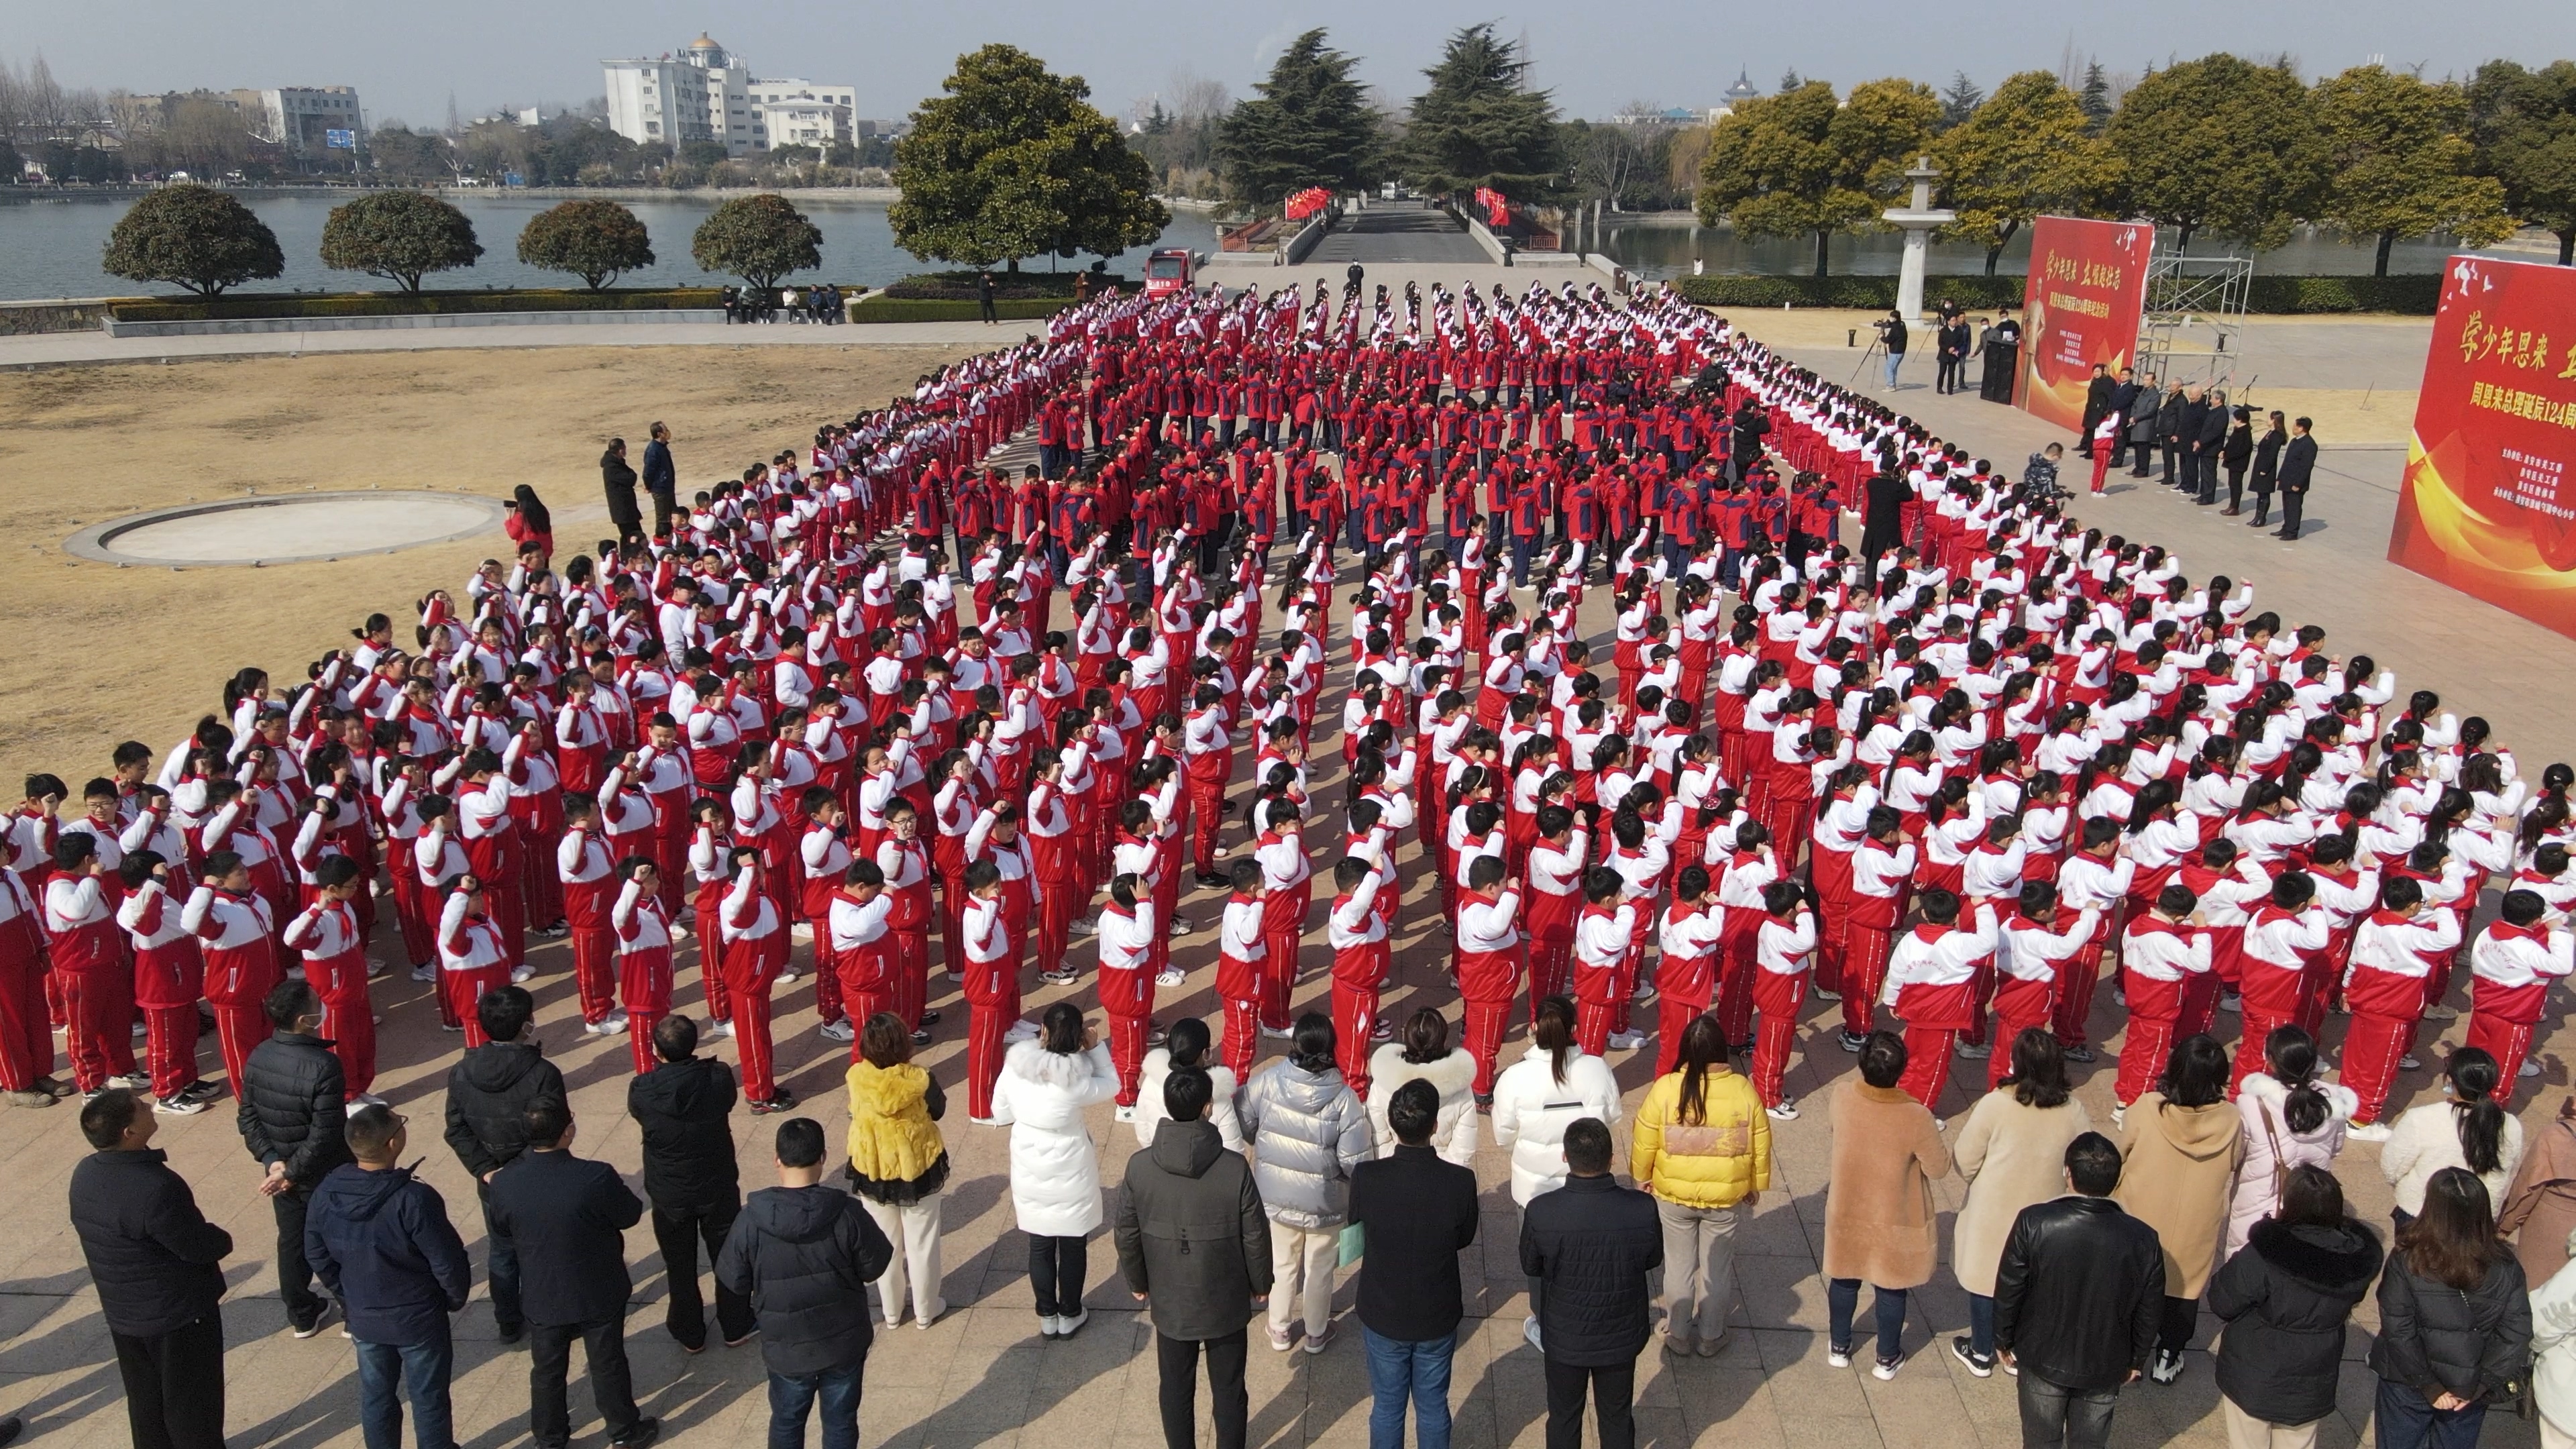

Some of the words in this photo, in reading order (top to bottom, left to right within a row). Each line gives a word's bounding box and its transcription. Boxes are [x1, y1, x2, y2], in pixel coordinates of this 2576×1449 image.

[2459, 309, 2548, 372] 学少年恩来
[2469, 380, 2576, 430] 周恩来总理诞辰124周
